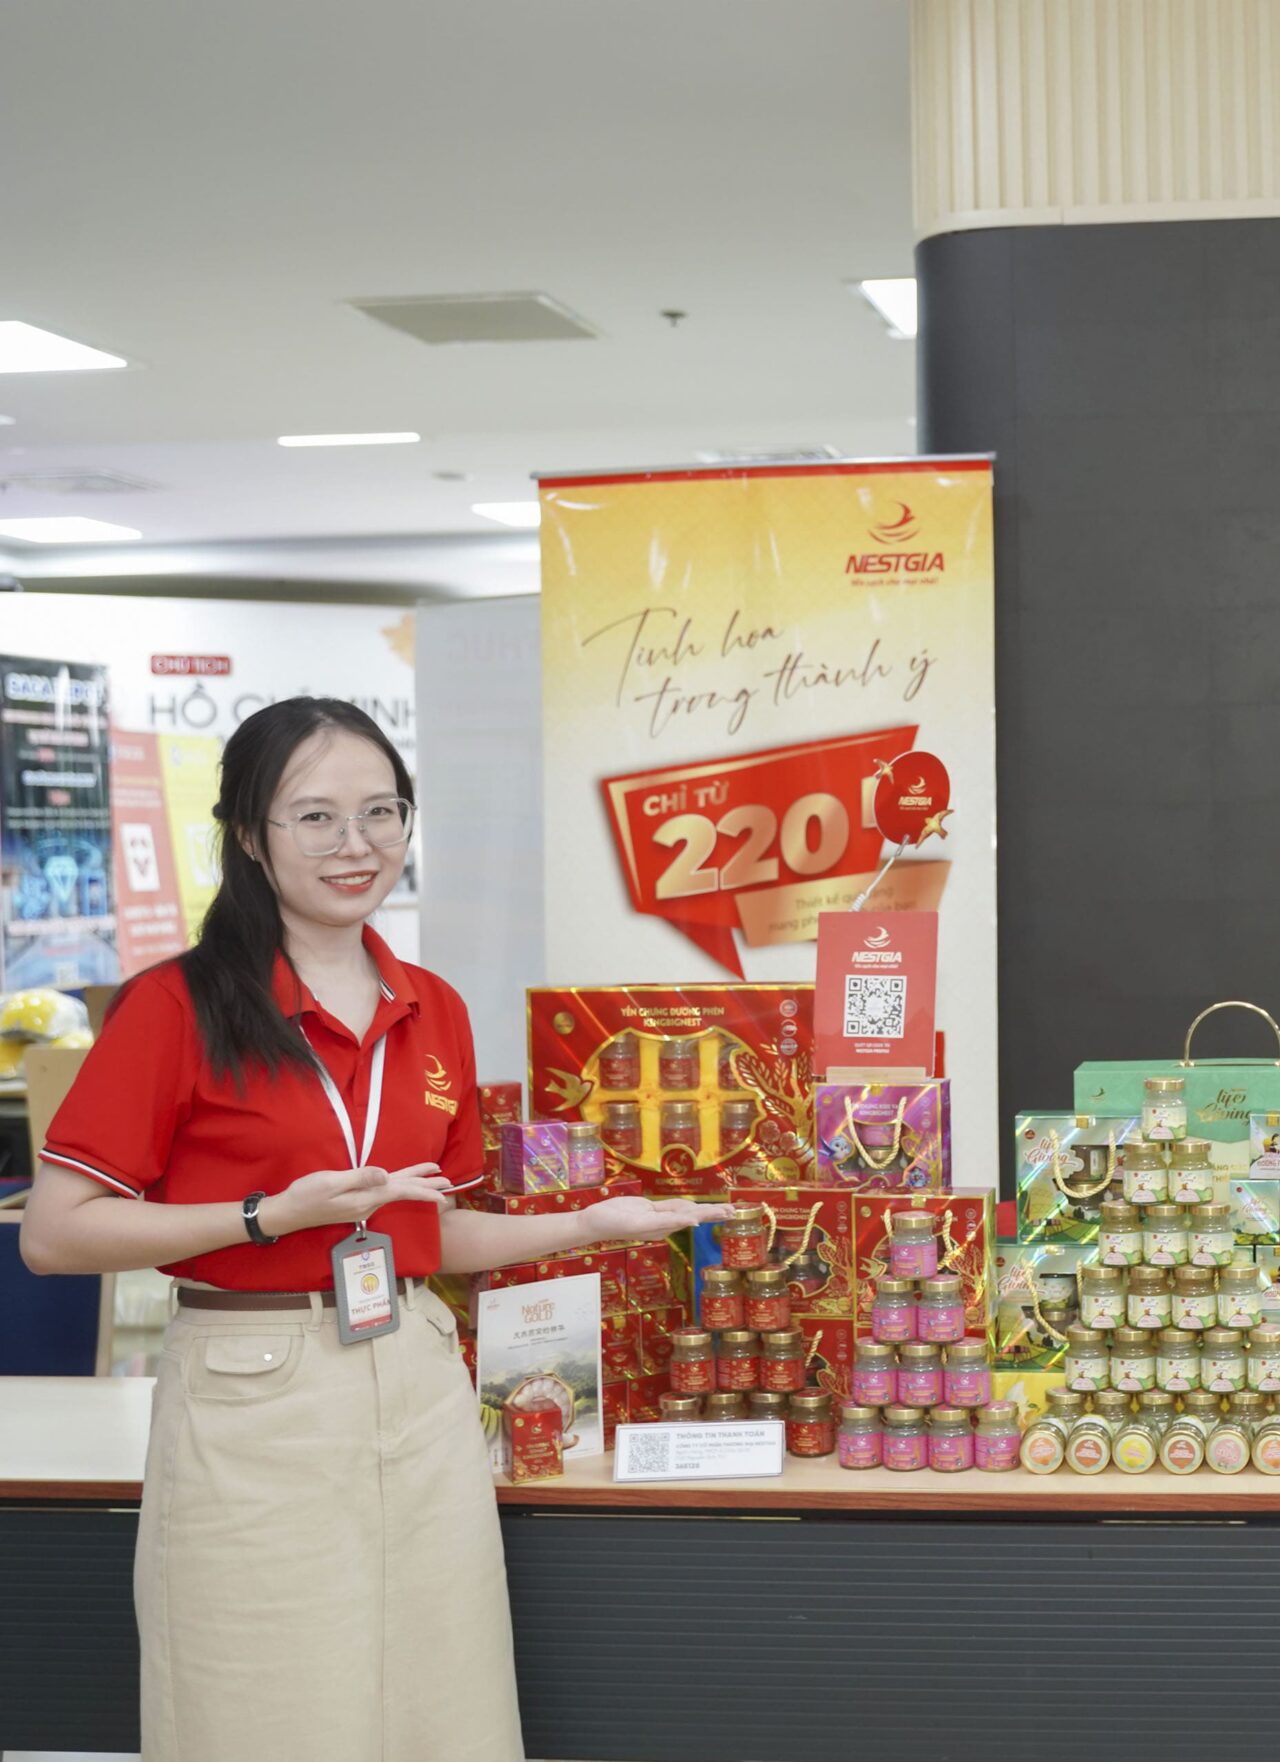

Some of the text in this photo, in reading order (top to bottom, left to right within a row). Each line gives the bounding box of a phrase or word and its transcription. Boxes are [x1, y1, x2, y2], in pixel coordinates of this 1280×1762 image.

[845, 552, 945, 574] NESTGIA
[721, 608, 784, 657] hoa
[149, 680, 218, 729] HỒ
[634, 638, 939, 738] trong thành ý
[643, 780, 730, 817] CHỈ TỪ
[898, 796, 933, 807] NESTGIA
[852, 951, 903, 963] NESTGIA
